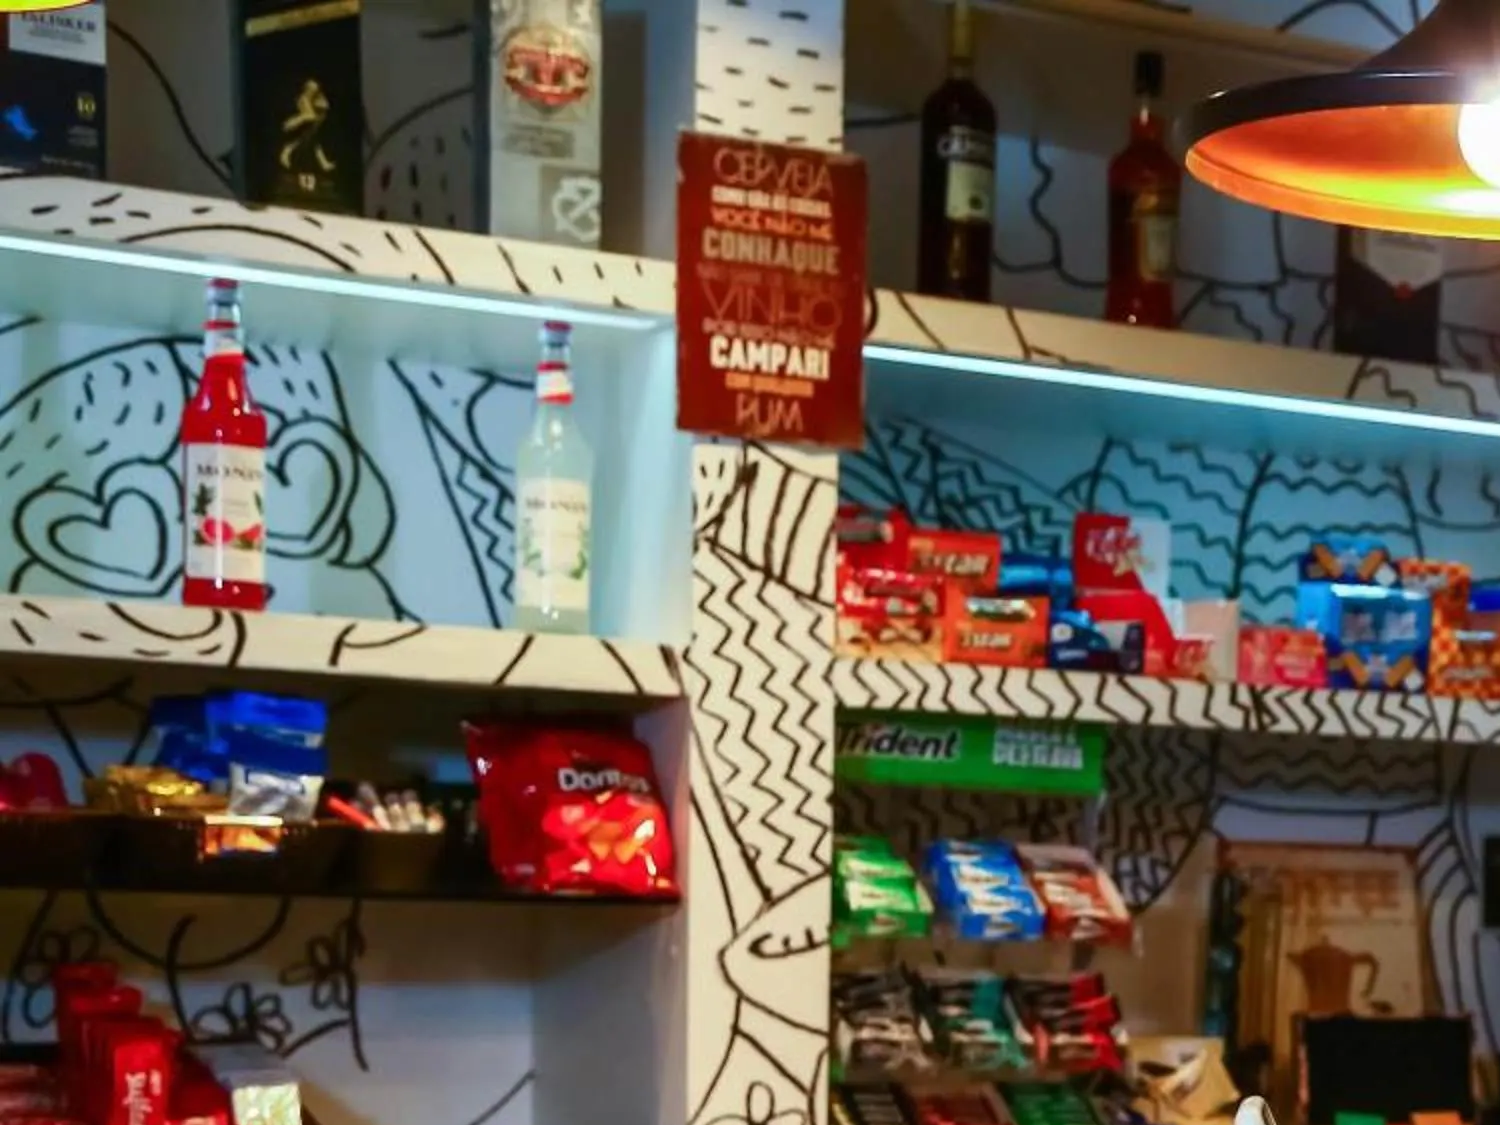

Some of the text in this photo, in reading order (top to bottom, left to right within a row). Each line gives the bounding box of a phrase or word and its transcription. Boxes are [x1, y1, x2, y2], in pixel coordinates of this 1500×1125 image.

[702, 226, 841, 276] CONHAQUE
[700, 277, 844, 333] VINHO
[709, 334, 830, 381] CAMPARI
